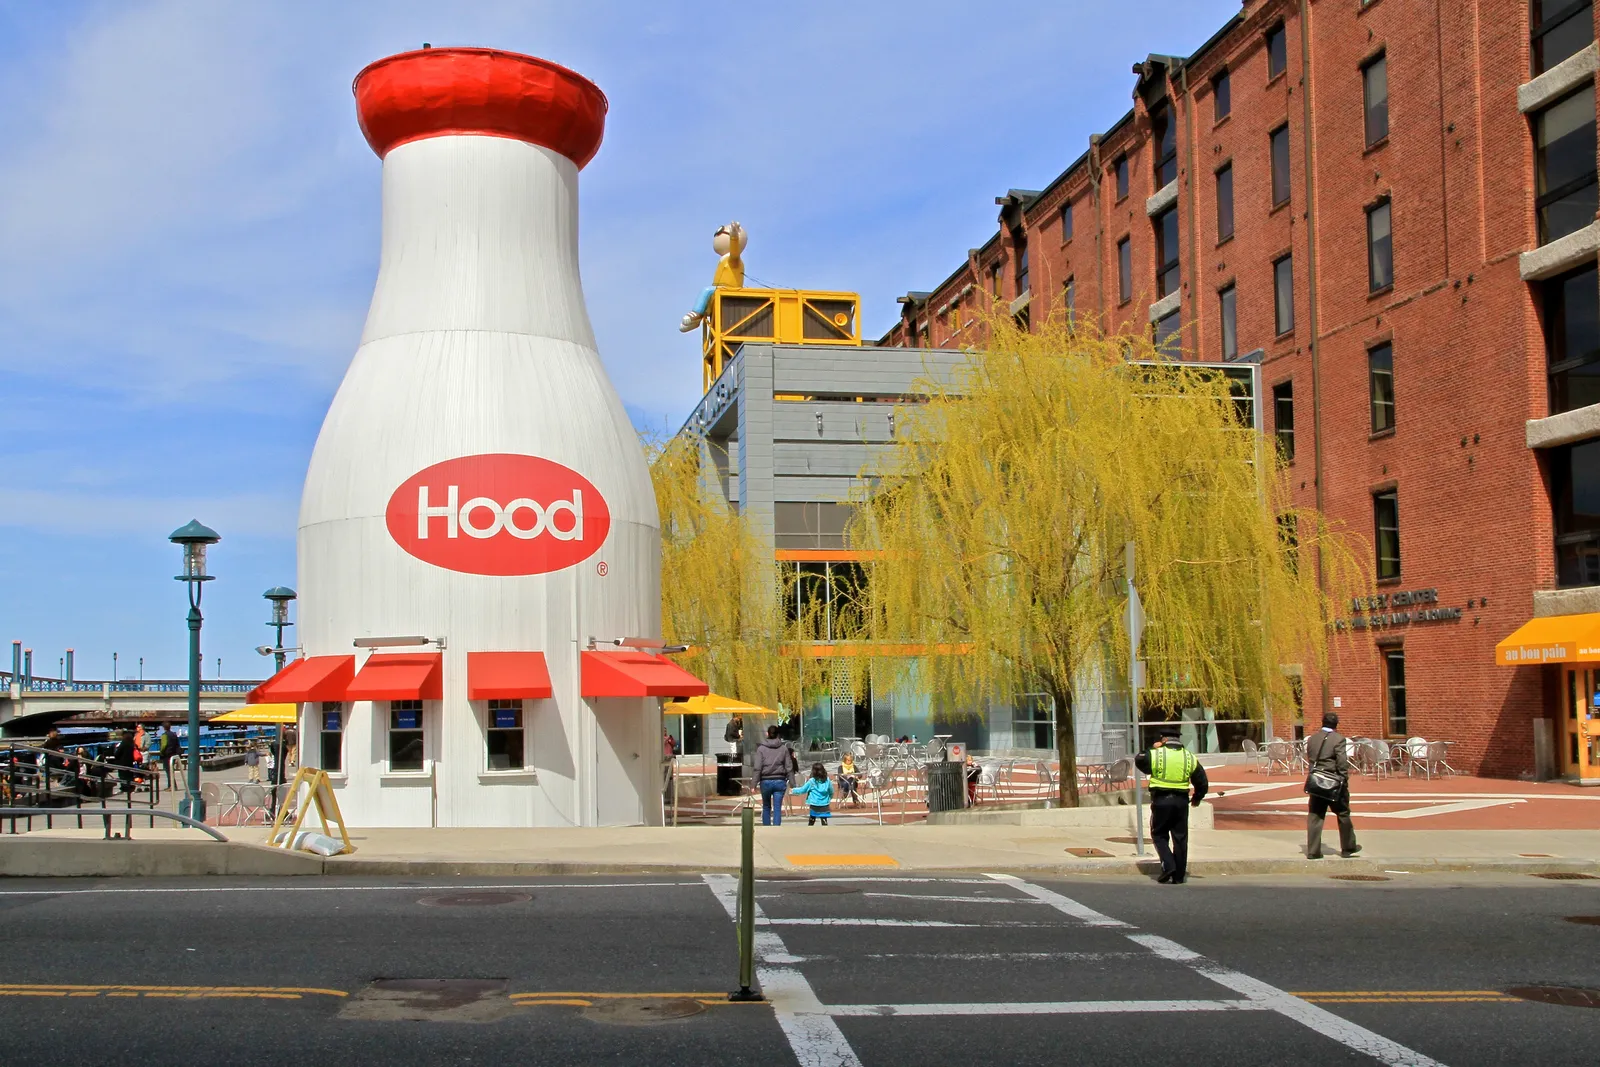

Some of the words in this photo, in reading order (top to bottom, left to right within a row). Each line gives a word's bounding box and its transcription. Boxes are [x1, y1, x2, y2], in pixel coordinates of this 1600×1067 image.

[417, 485, 584, 541] Hood
[1505, 649, 1519, 661] au
[1520, 645, 1541, 660] bon
[1542, 643, 1567, 663] pain
